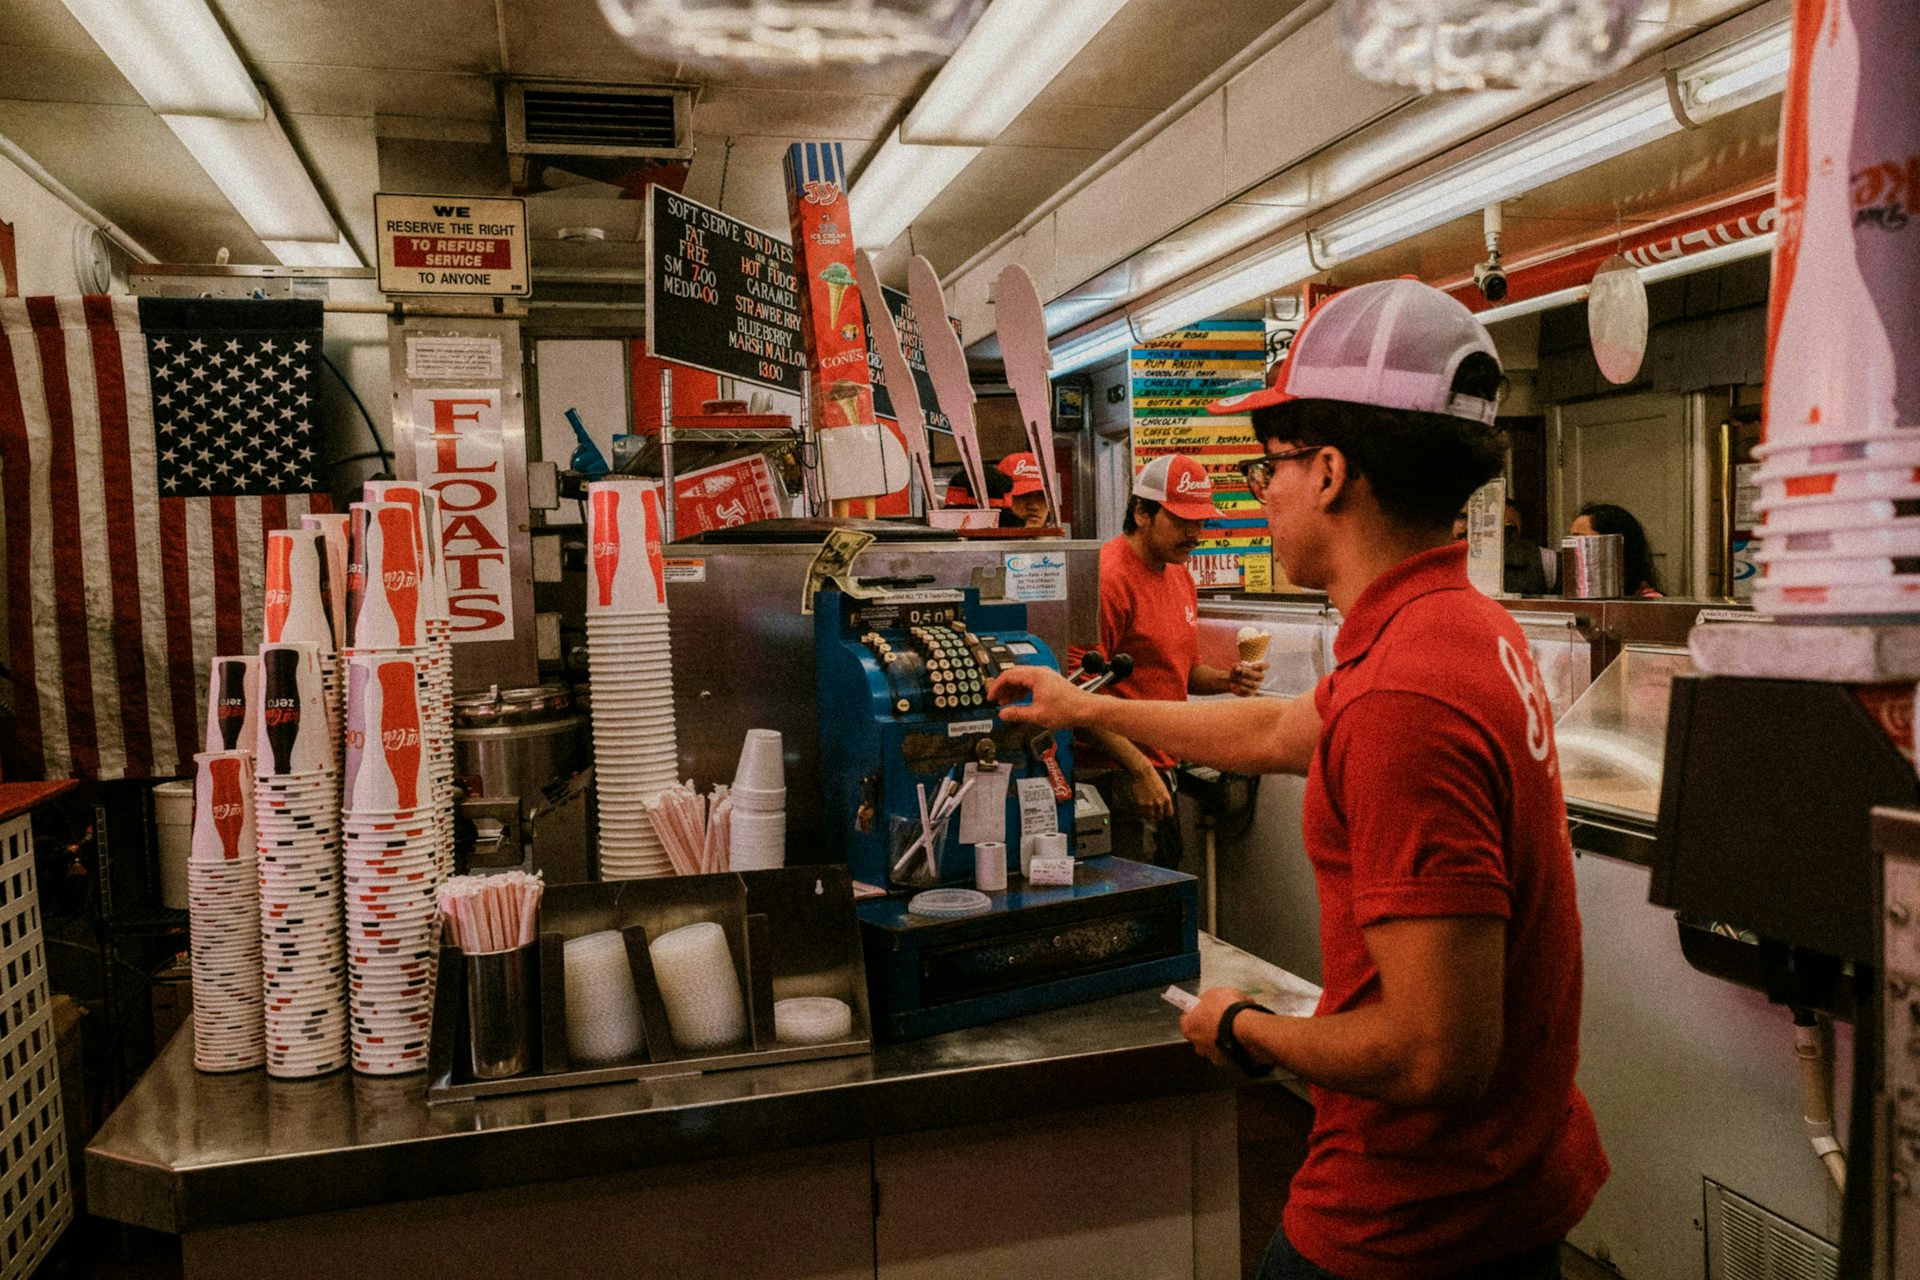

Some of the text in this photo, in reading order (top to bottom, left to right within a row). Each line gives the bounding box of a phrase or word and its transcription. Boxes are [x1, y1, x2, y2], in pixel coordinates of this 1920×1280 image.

[433, 205, 471, 218] WE
[387, 220, 516, 237] RESERVE THE RIGHT
[668, 197, 794, 264] SOFT SERVE SUNDAES
[685, 224, 705, 247] FAT
[410, 238, 495, 253] TO REFUSE
[679, 239, 710, 267] FREE
[425, 253, 482, 267] SERVICE
[755, 253, 766, 265] OUR
[418, 272, 491, 285] TO ANYONE
[664, 255, 717, 288] SM 7.00
[741, 256, 798, 293] HOT FUDGE
[746, 278, 797, 310] CARAMEL
[735, 294, 802, 332] STRAWBERRY
[737, 316, 793, 348] BLUEBERRY
[1184, 331, 1209, 339] ROAD
[821, 352, 865, 369] CONES
[1144, 359, 1205, 368] RUM RAISIN
[758, 360, 783, 382] 13.00
[1141, 418, 1189, 426] CHOCOLATE
[428, 399, 507, 632] FLOATS
[1186, 554, 1239, 571] PRINKLES
[267, 698, 295, 708] zero
